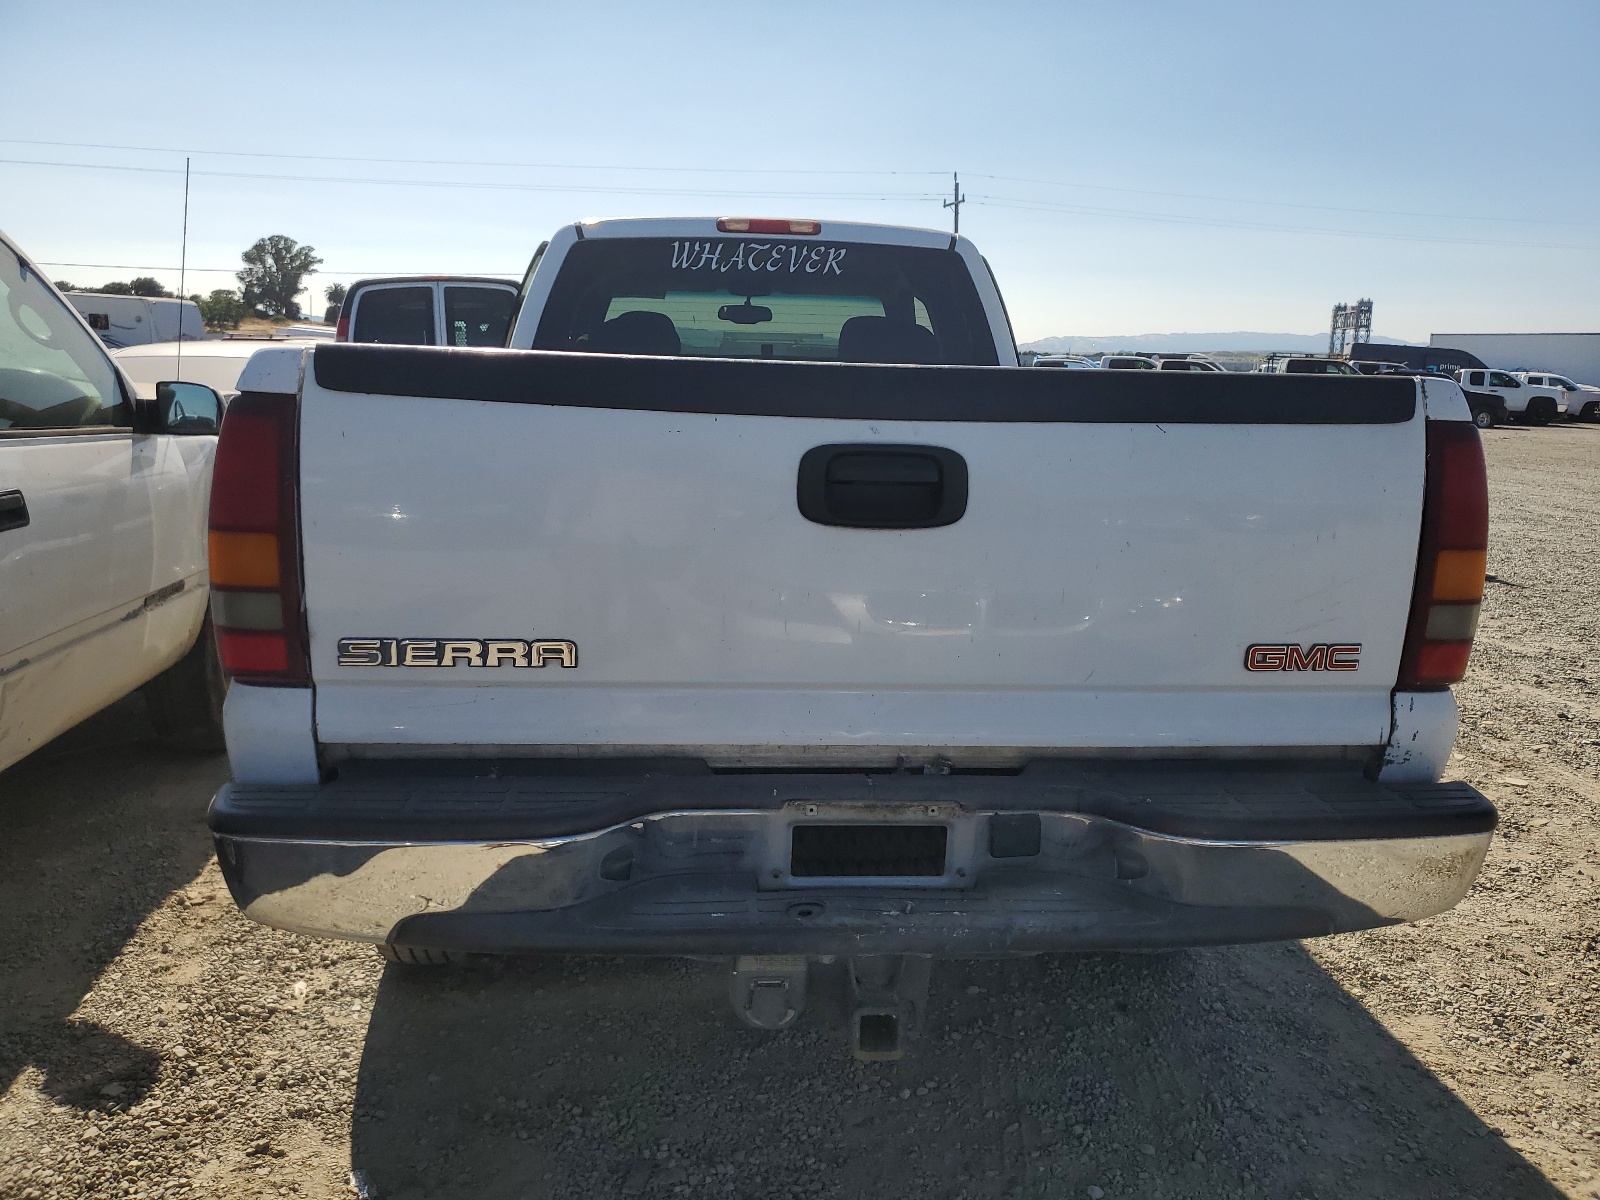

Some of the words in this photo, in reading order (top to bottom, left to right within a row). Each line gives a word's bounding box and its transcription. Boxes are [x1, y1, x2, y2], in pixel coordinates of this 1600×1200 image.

[671, 240, 847, 275] WHATEVER
[1439, 363, 1461, 371] prime
[337, 637, 578, 669] SIERRA
[1244, 643, 1362, 671] GMC
